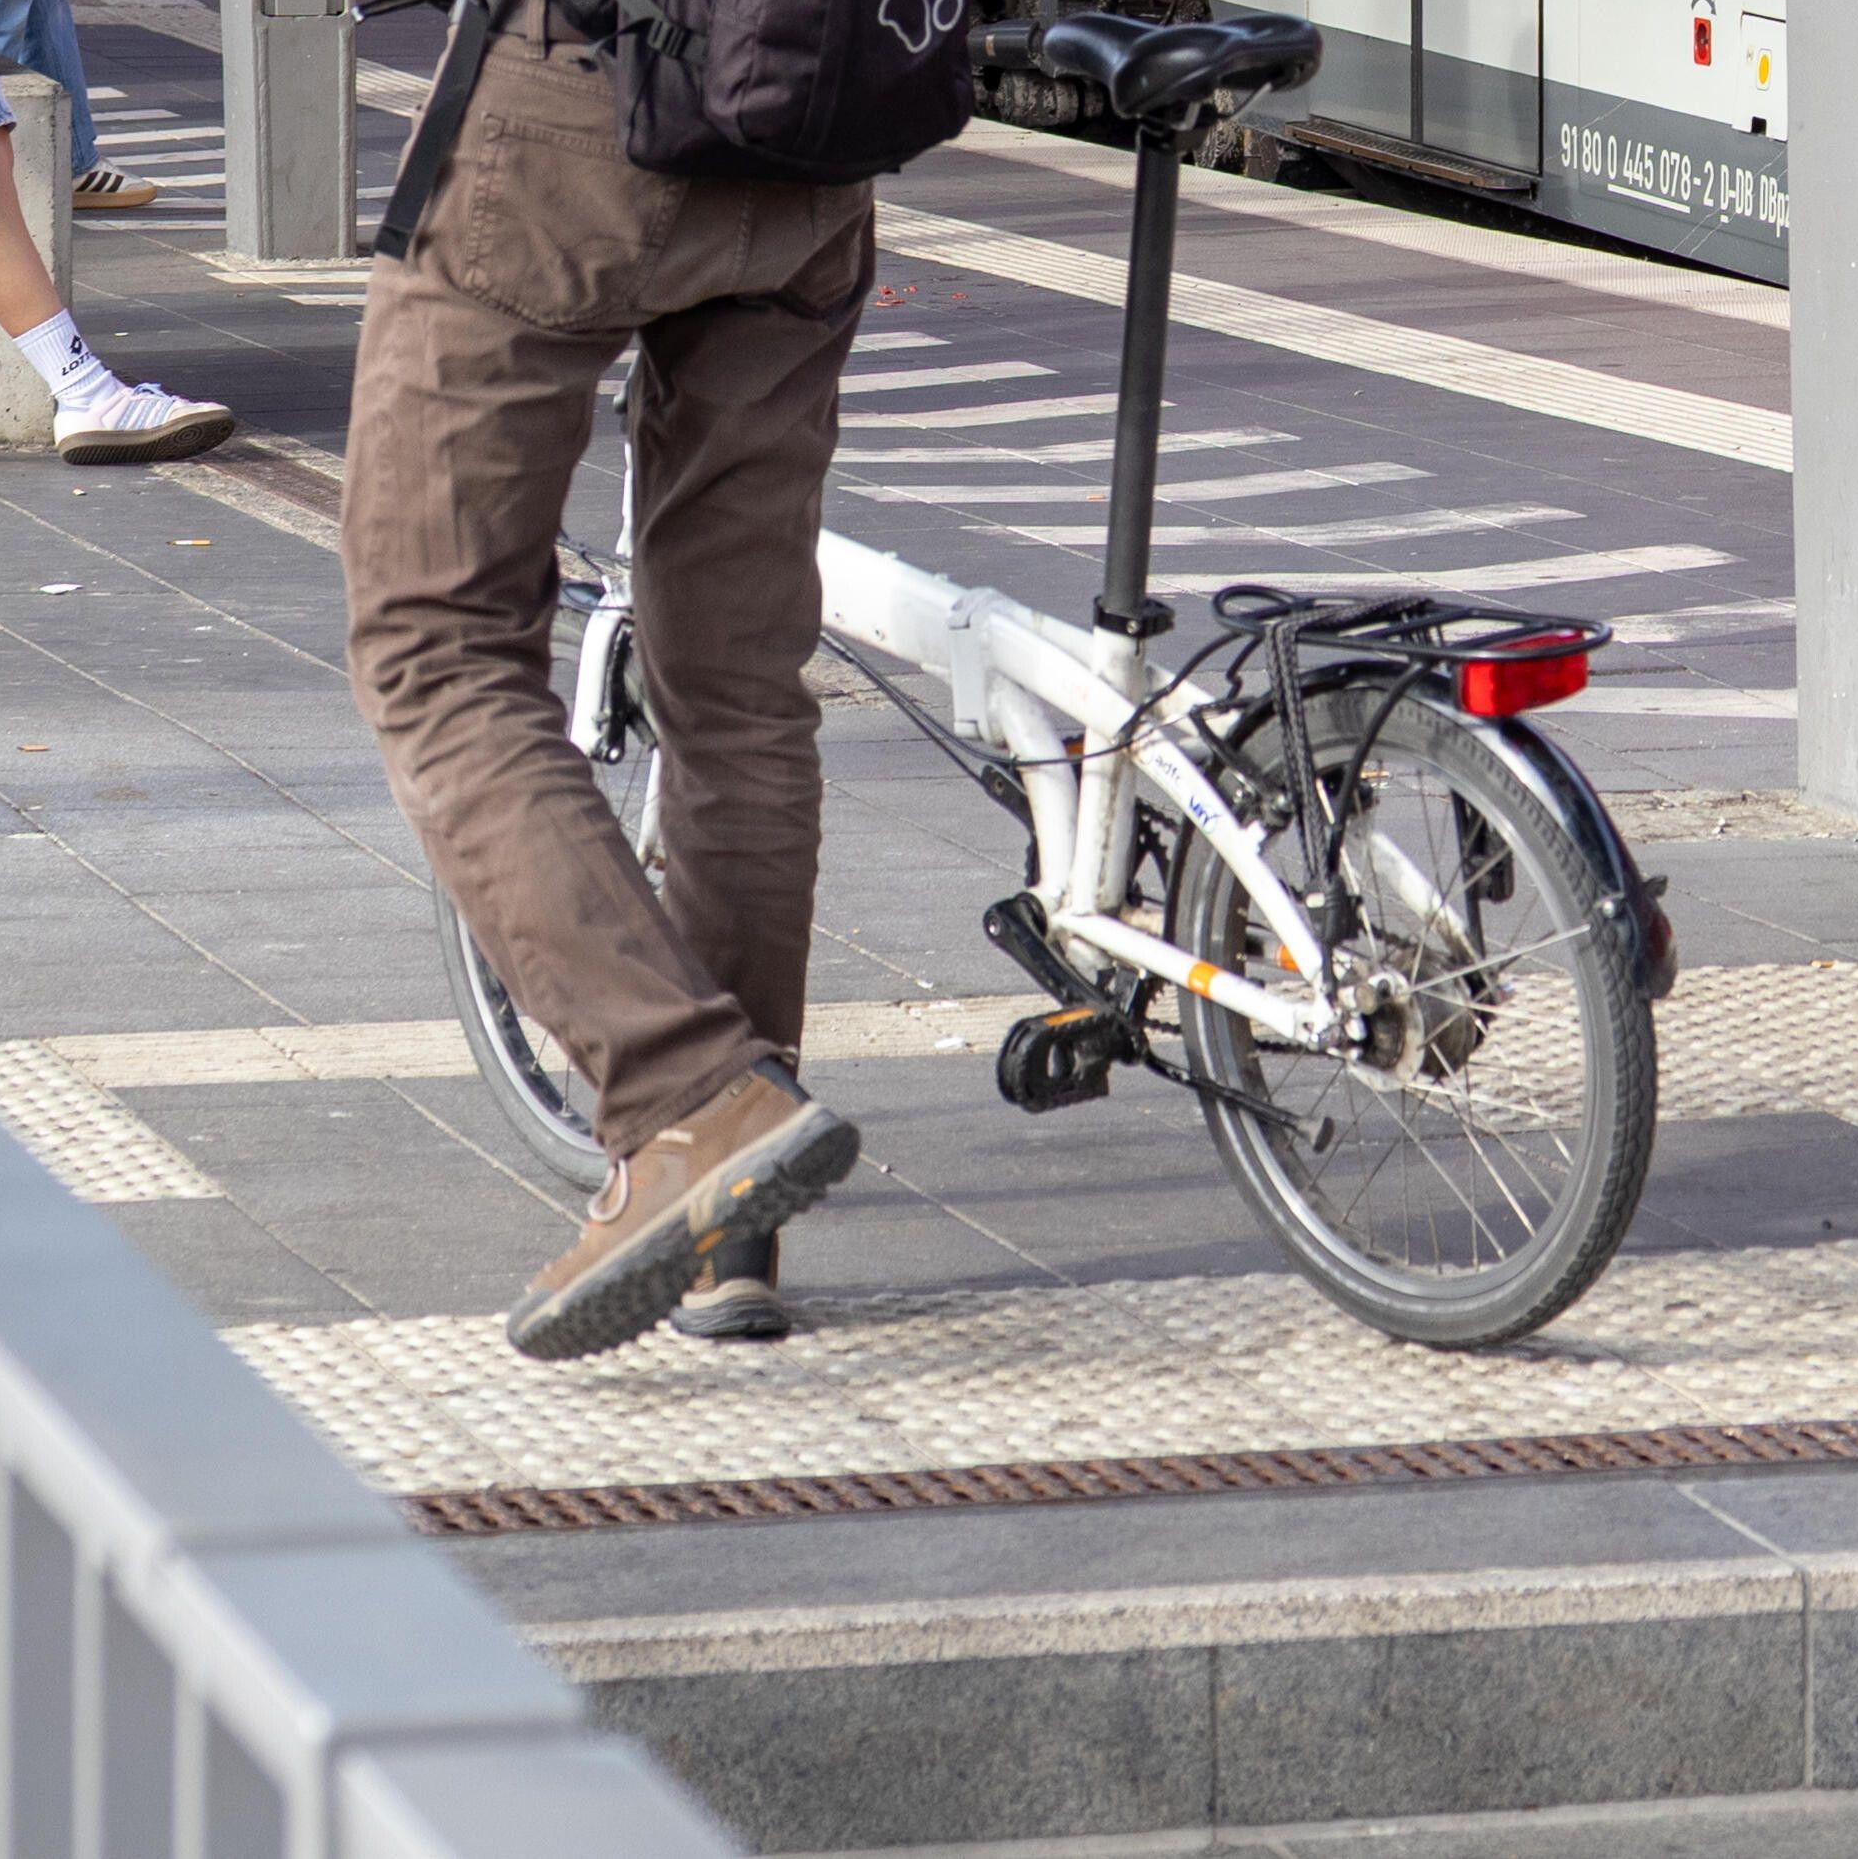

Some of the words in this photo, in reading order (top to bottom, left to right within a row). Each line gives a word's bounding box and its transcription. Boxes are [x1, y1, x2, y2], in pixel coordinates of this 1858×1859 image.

[1561, 122, 1578, 170] 91
[1582, 128, 1602, 176] 80
[1607, 135, 1618, 180] 0
[1622, 140, 1654, 191] 445
